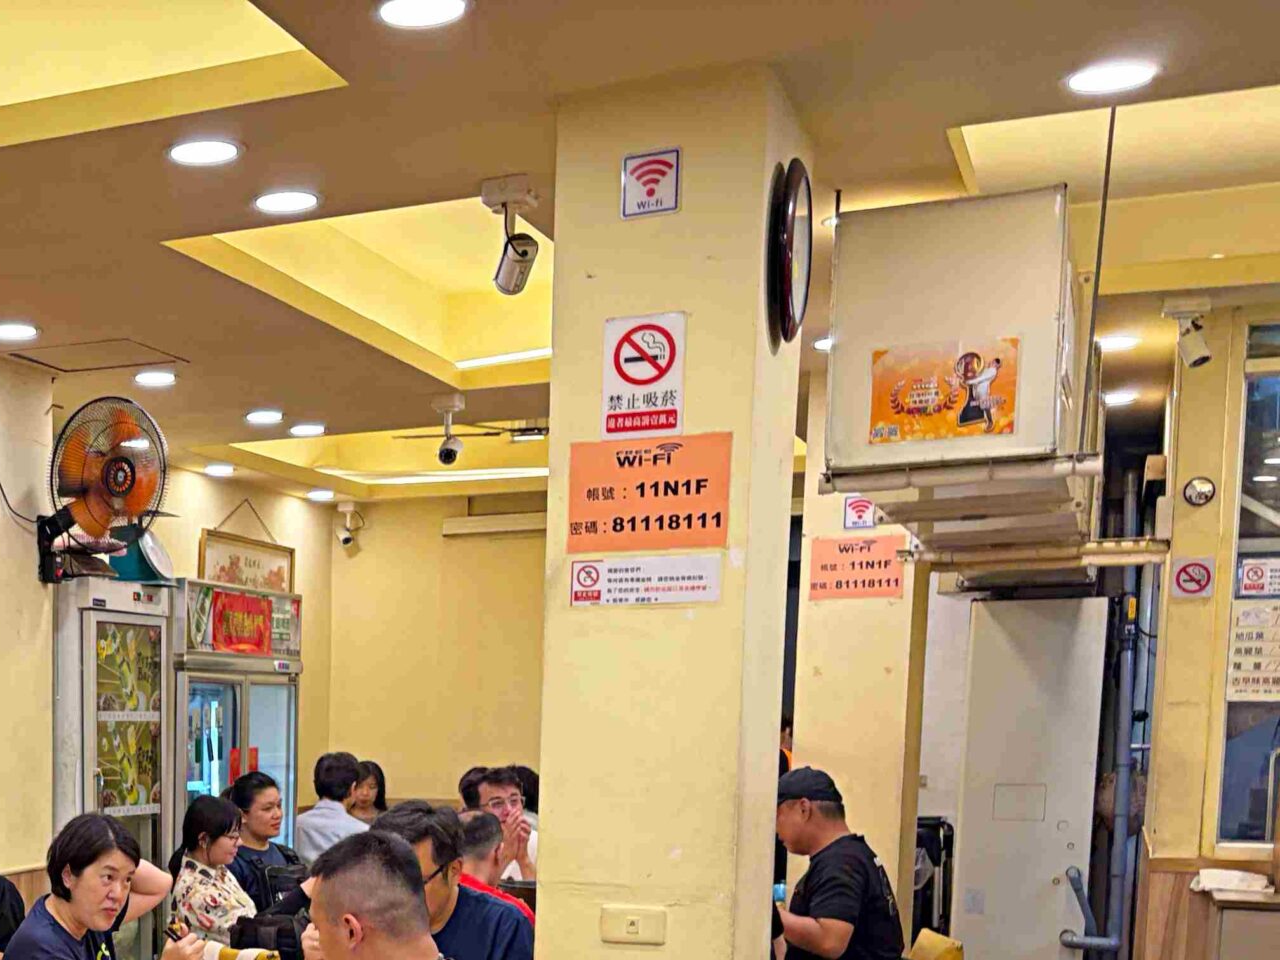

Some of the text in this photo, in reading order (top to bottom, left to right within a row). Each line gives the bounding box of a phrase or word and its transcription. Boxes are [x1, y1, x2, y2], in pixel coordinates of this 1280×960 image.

[607, 390, 677, 411] 禁止吸菸
[635, 478, 708, 498] 11N1F
[612, 512, 722, 533] 81118111
[849, 559, 892, 571] 11N1F
